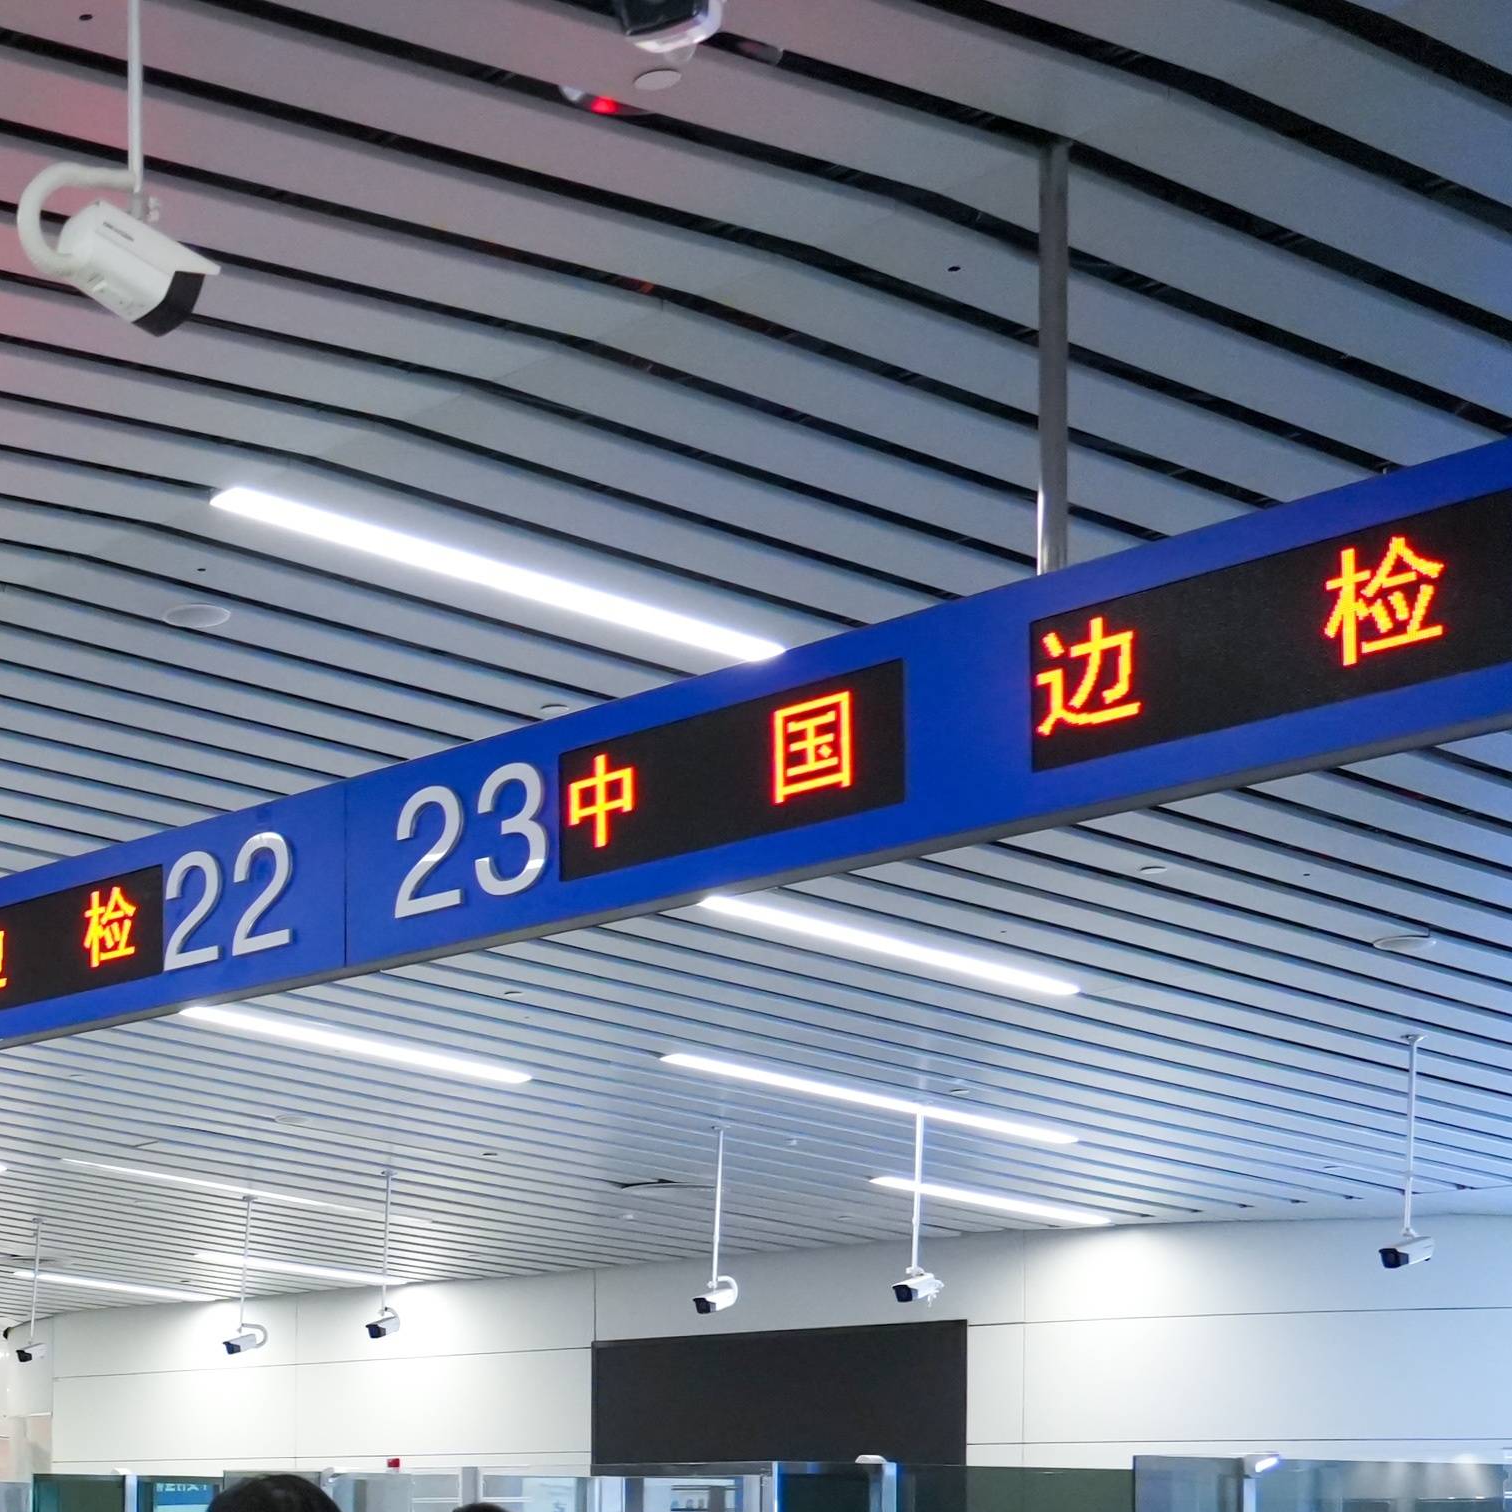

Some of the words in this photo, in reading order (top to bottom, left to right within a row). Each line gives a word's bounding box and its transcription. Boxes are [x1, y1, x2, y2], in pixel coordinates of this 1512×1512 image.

[1034, 534, 1447, 738] 边检
[395, 761, 550, 919] 23
[567, 688, 855, 848] 中国
[164, 831, 294, 972] 22
